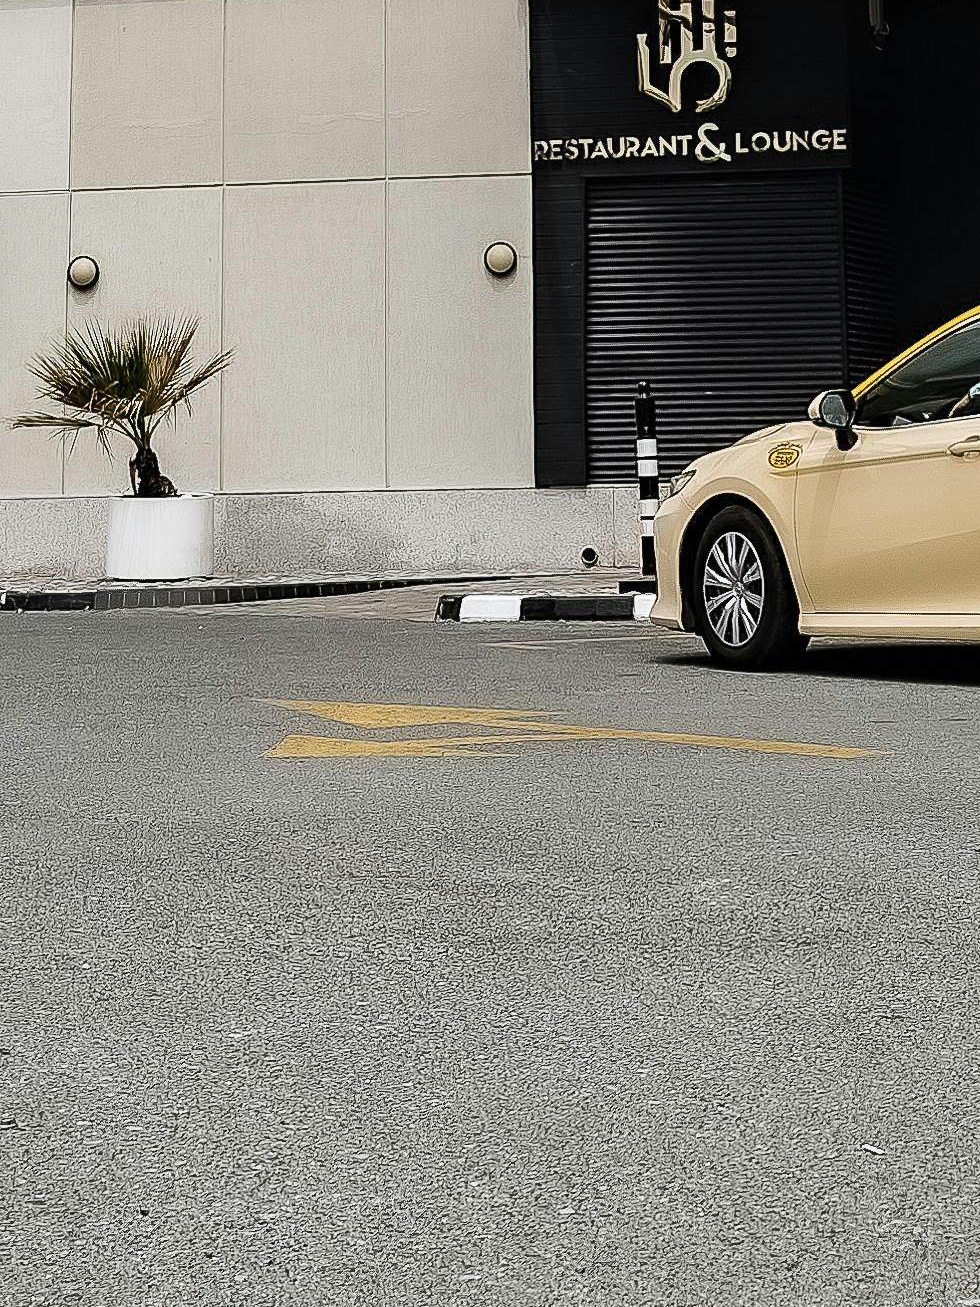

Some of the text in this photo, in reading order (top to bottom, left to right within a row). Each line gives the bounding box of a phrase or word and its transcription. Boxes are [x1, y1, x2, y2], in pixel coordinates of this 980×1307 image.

[534, 122, 848, 162] RESTAURANT & LOUNGE
